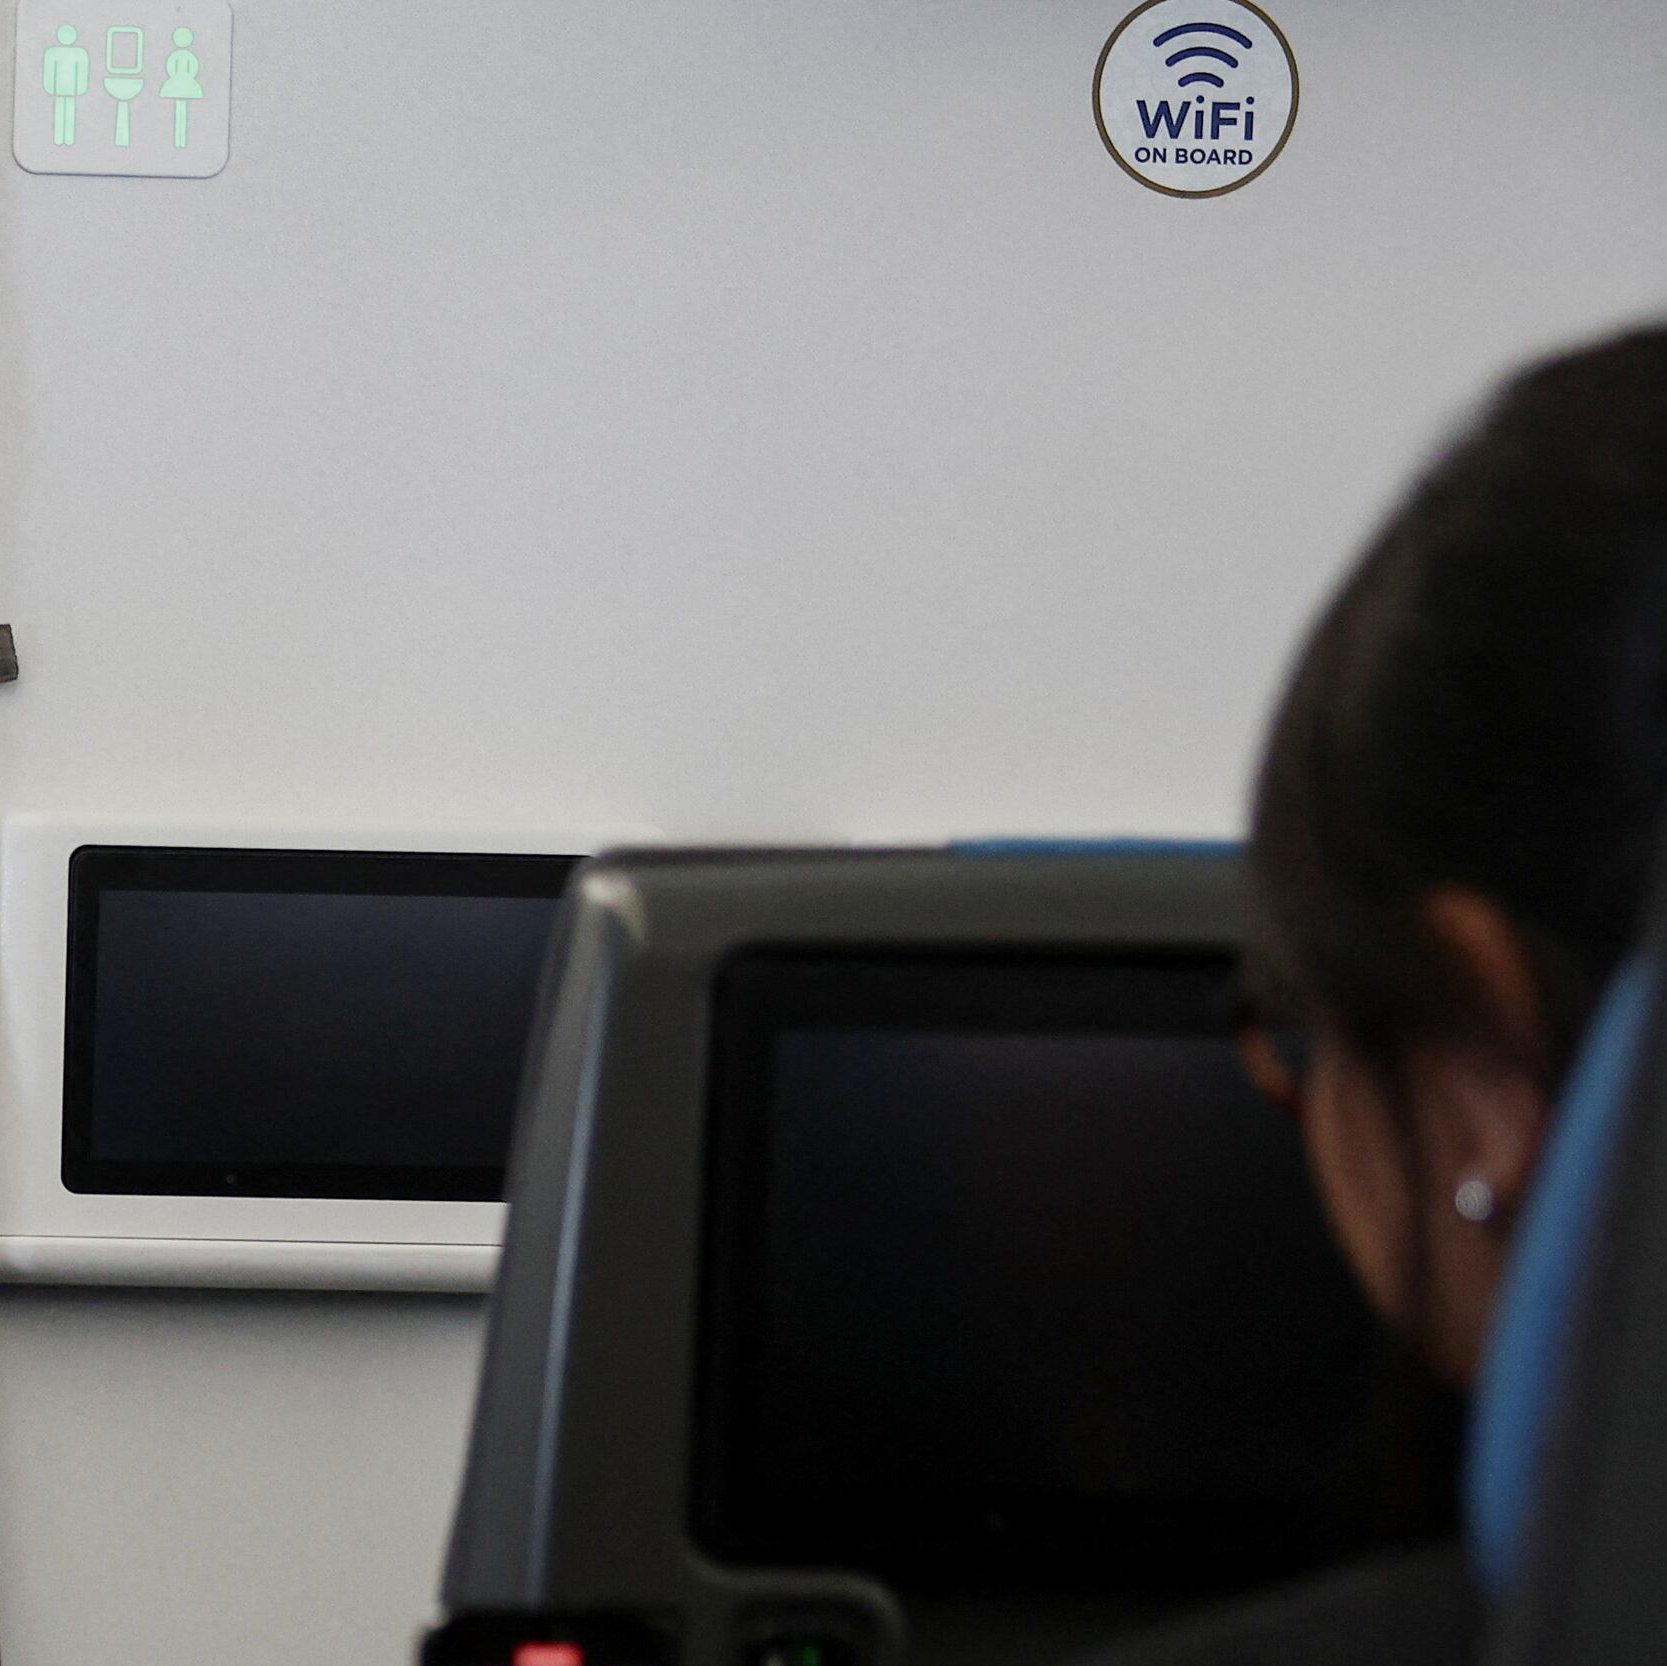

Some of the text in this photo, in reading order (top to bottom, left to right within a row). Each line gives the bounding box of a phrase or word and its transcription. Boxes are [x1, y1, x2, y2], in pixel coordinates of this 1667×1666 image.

[1136, 95, 1255, 141] WiFi
[1134, 147, 1253, 165] ON BOARD
